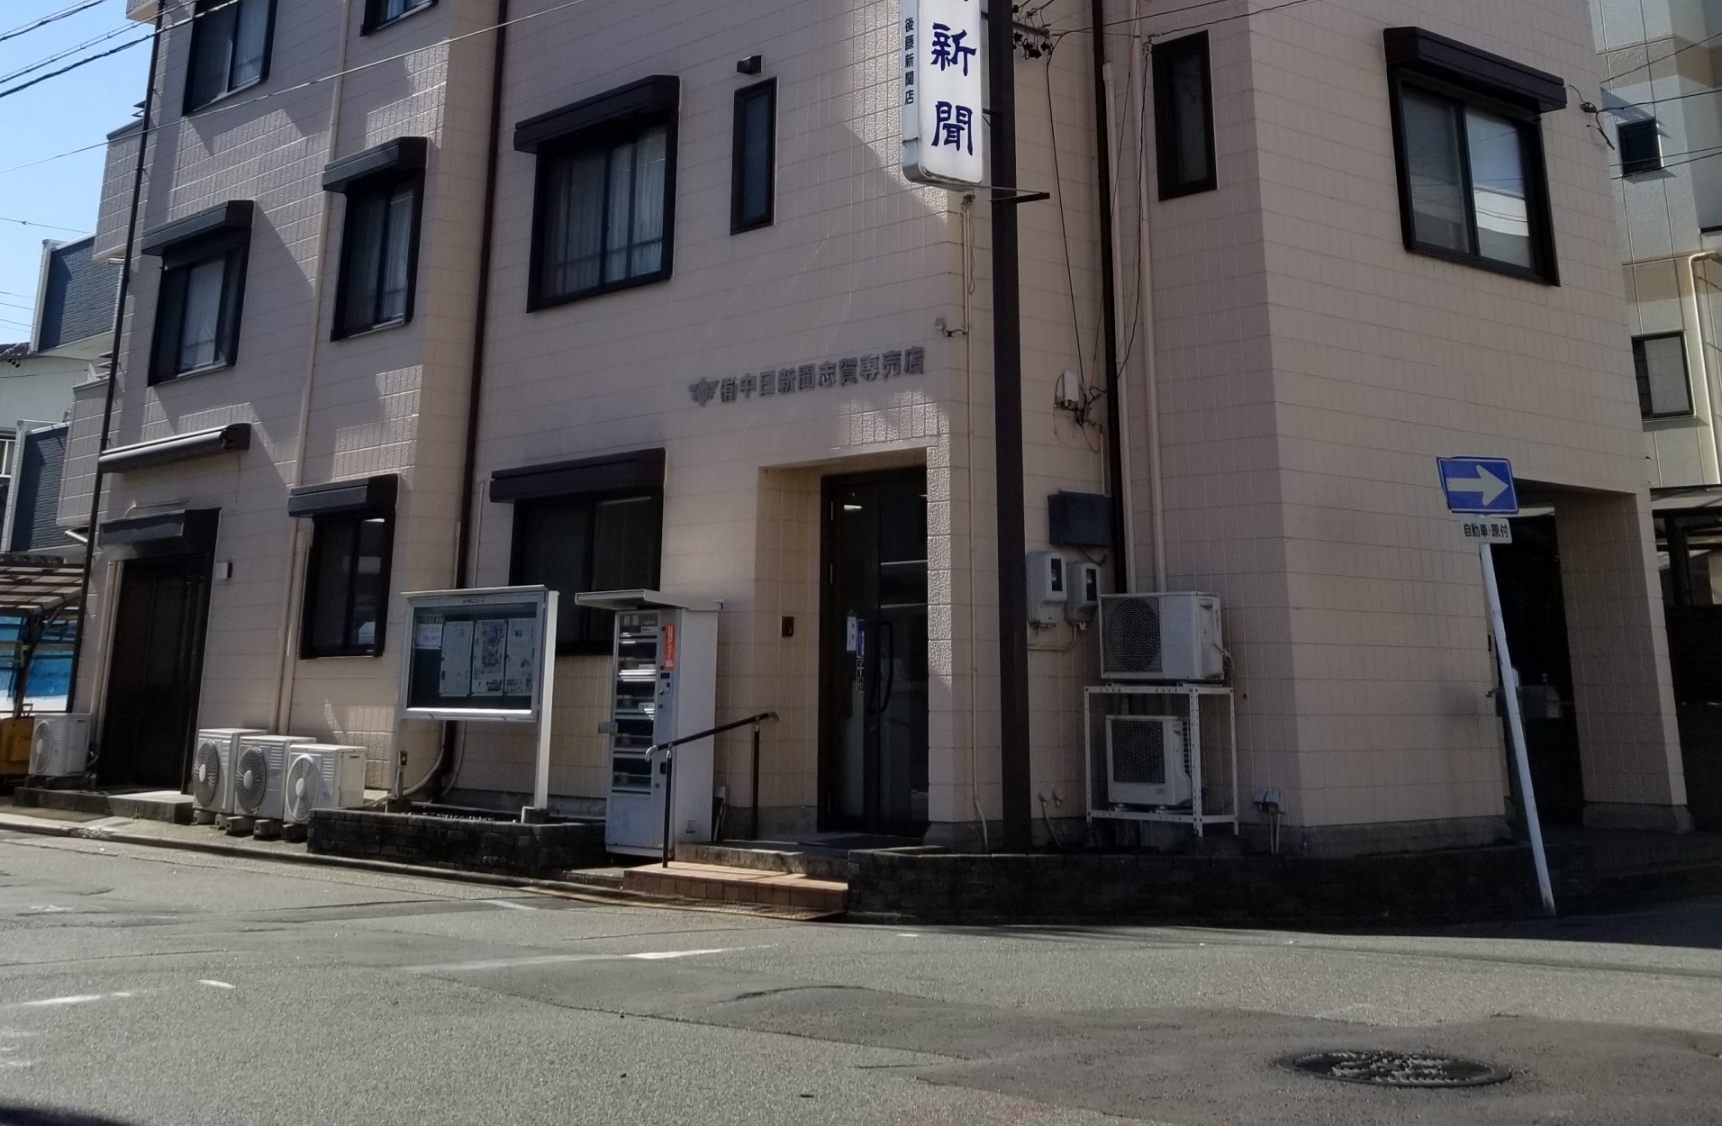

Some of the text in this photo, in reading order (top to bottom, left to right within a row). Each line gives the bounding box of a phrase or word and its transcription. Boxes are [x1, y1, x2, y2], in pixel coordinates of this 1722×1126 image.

[904, 17, 915, 105] 後藤新聞店
